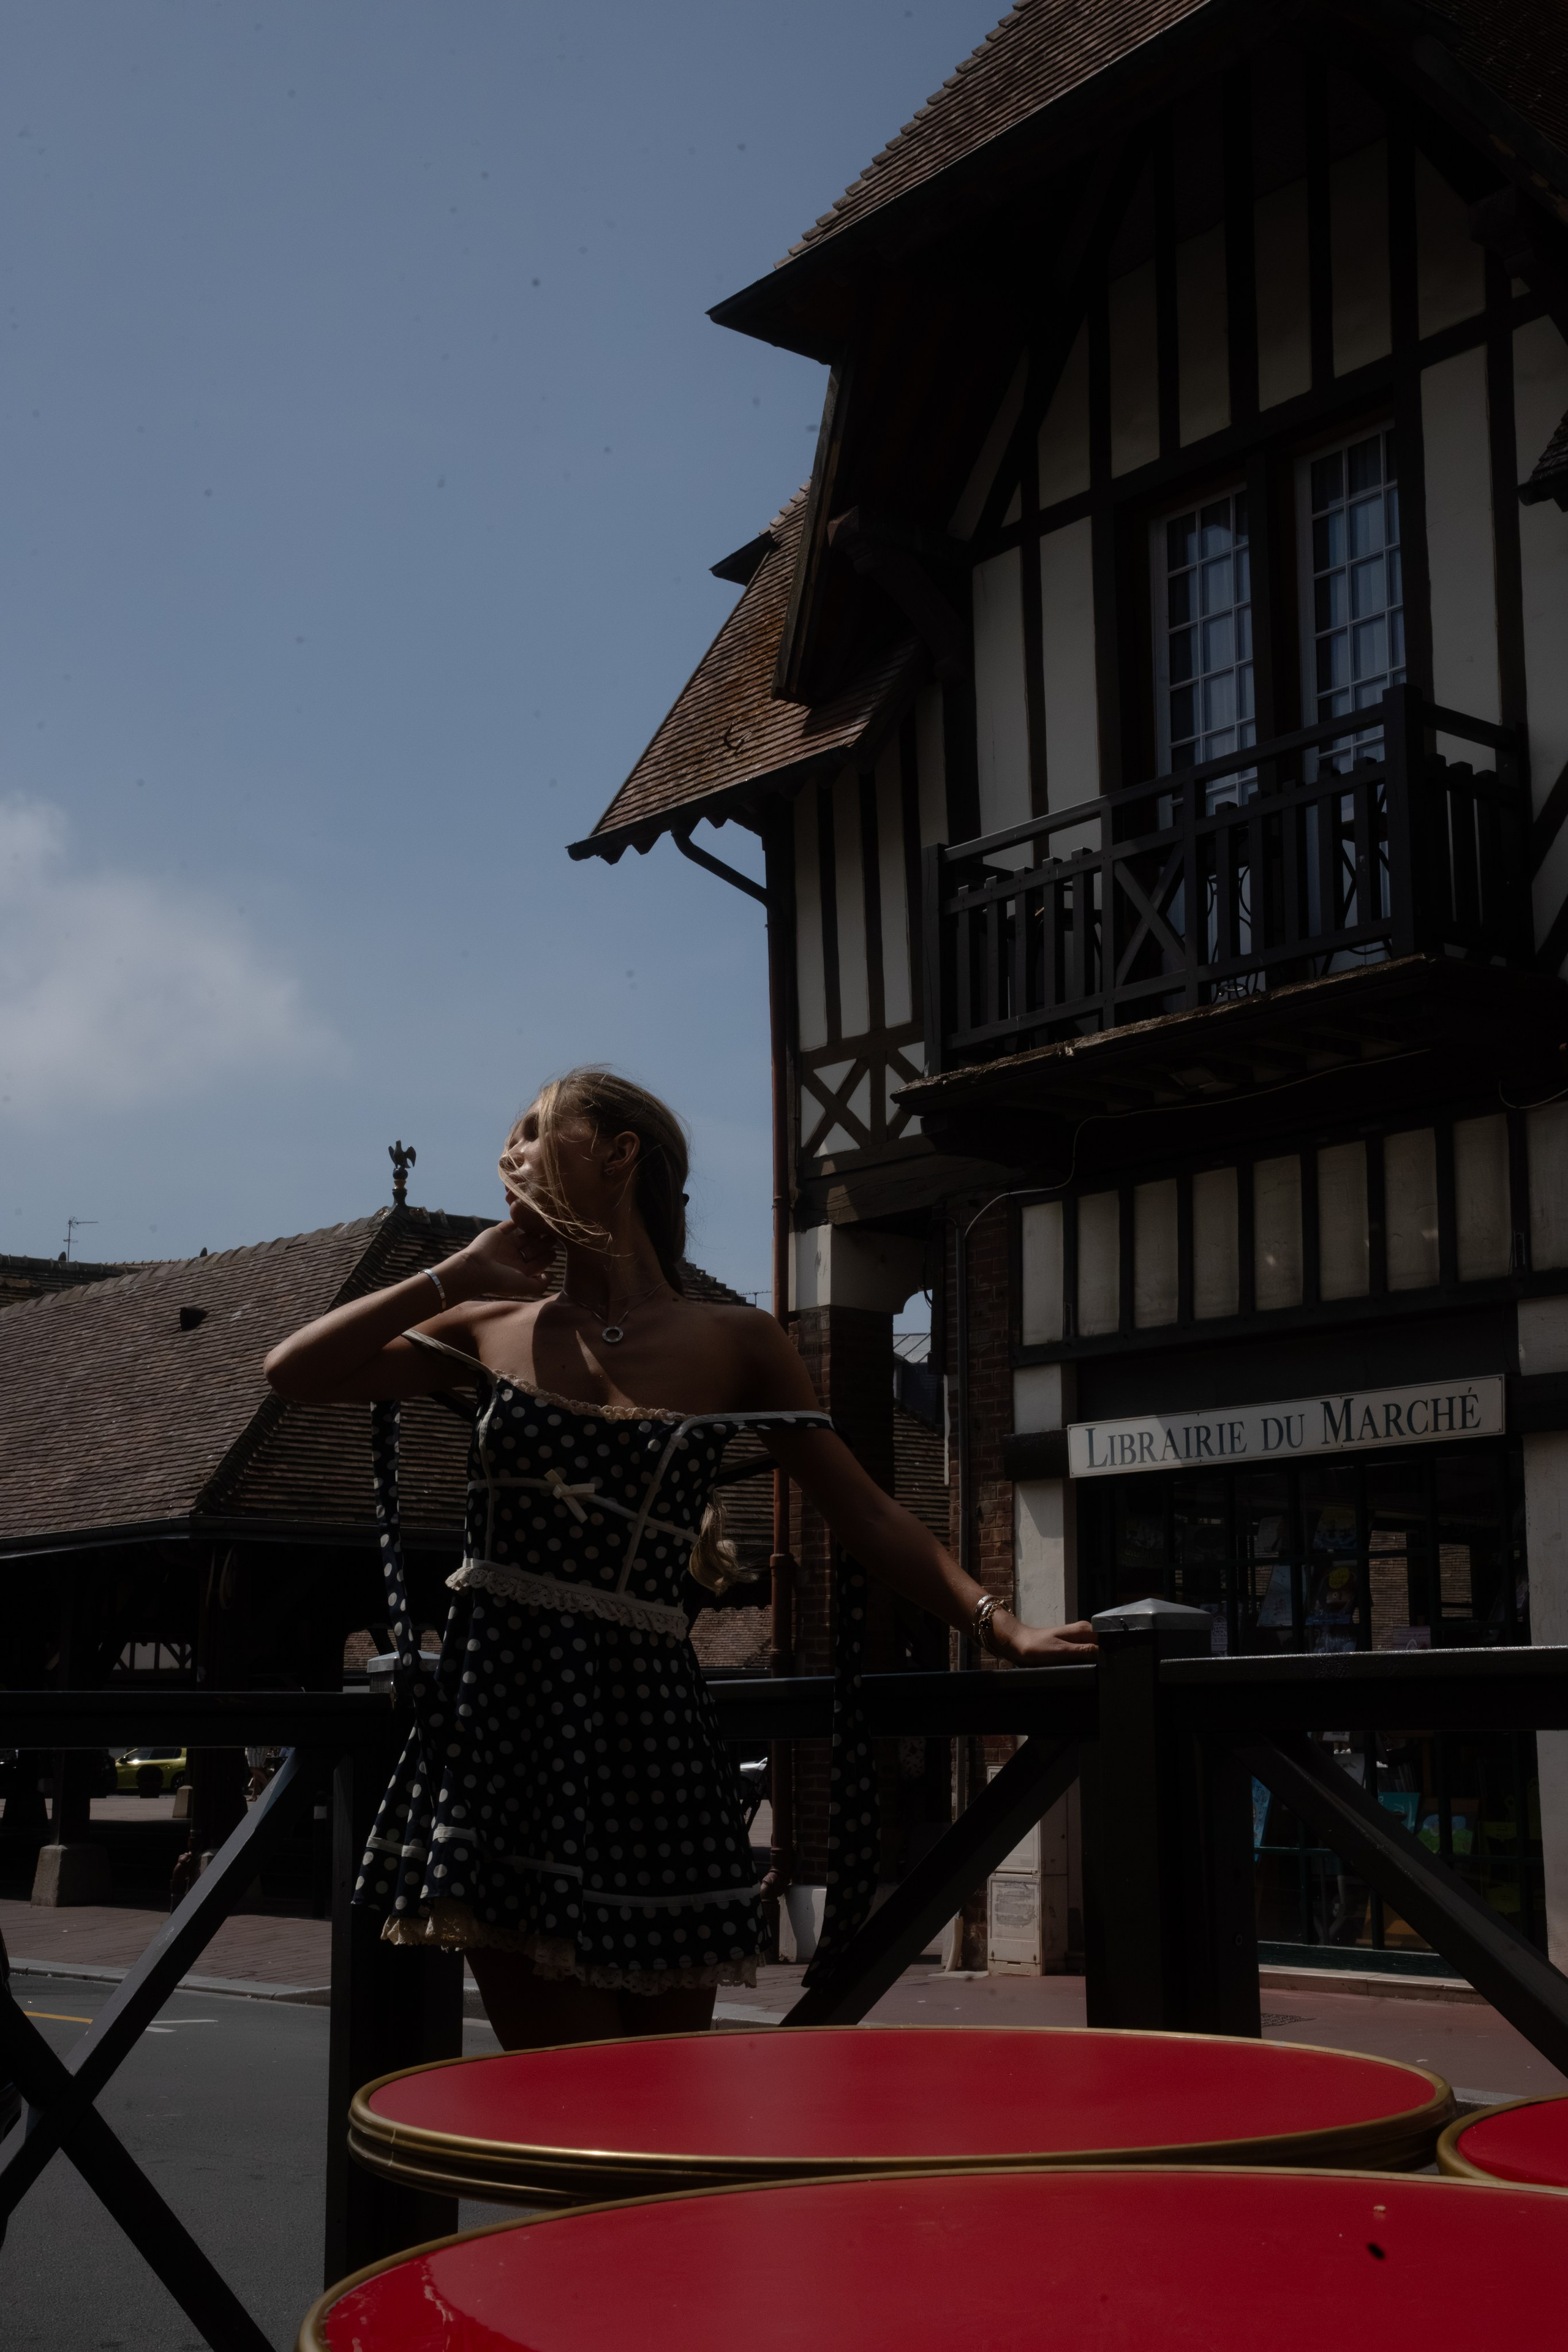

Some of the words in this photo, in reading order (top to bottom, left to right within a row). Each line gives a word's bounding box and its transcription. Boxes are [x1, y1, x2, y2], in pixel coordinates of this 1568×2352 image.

[1085, 1421, 1247, 1468] LIBRAIRIE
[1261, 1414, 1305, 1450] DU
[1321, 1387, 1481, 1445] MARCHÉ
